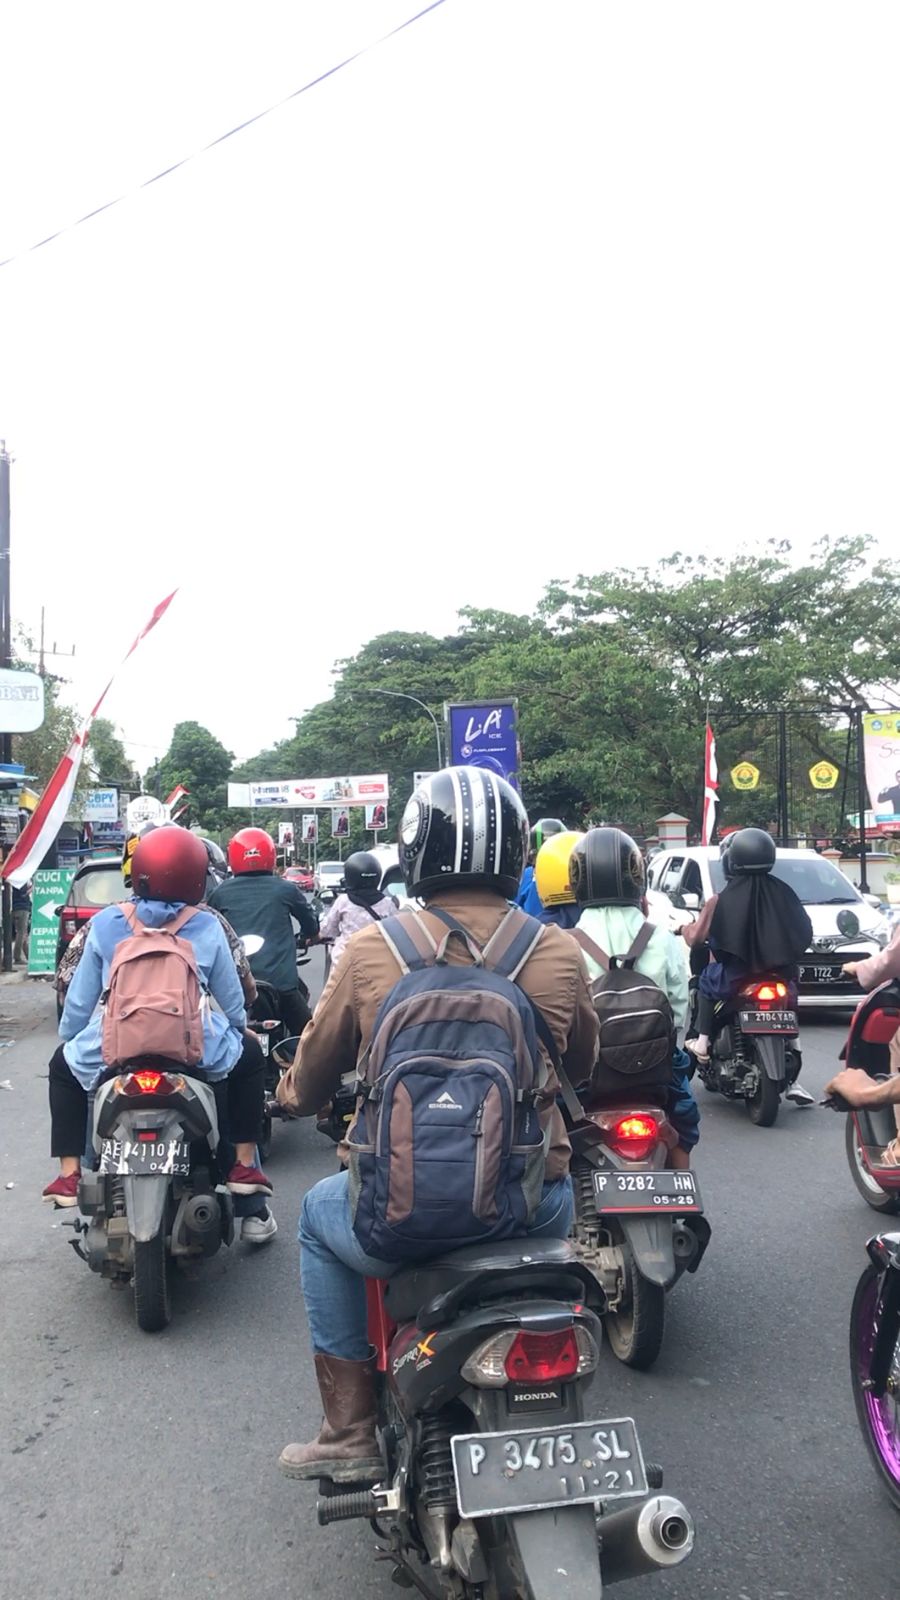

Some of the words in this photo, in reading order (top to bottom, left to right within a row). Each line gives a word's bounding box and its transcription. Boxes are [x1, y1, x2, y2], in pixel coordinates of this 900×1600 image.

[36, 872, 61, 882] CUCI
[35, 886, 64, 895] TANPA
[814, 967, 832, 977] 1722
[104, 1140, 121, 1159] AE
[598, 1176, 607, 1191] P
[617, 1175, 656, 1191] 3282
[673, 1176, 692, 1190] HN
[514, 1391, 558, 1402] HONDA
[469, 1443, 486, 1475] P
[504, 1434, 576, 1471] 3475
[592, 1430, 631, 1461] SL
